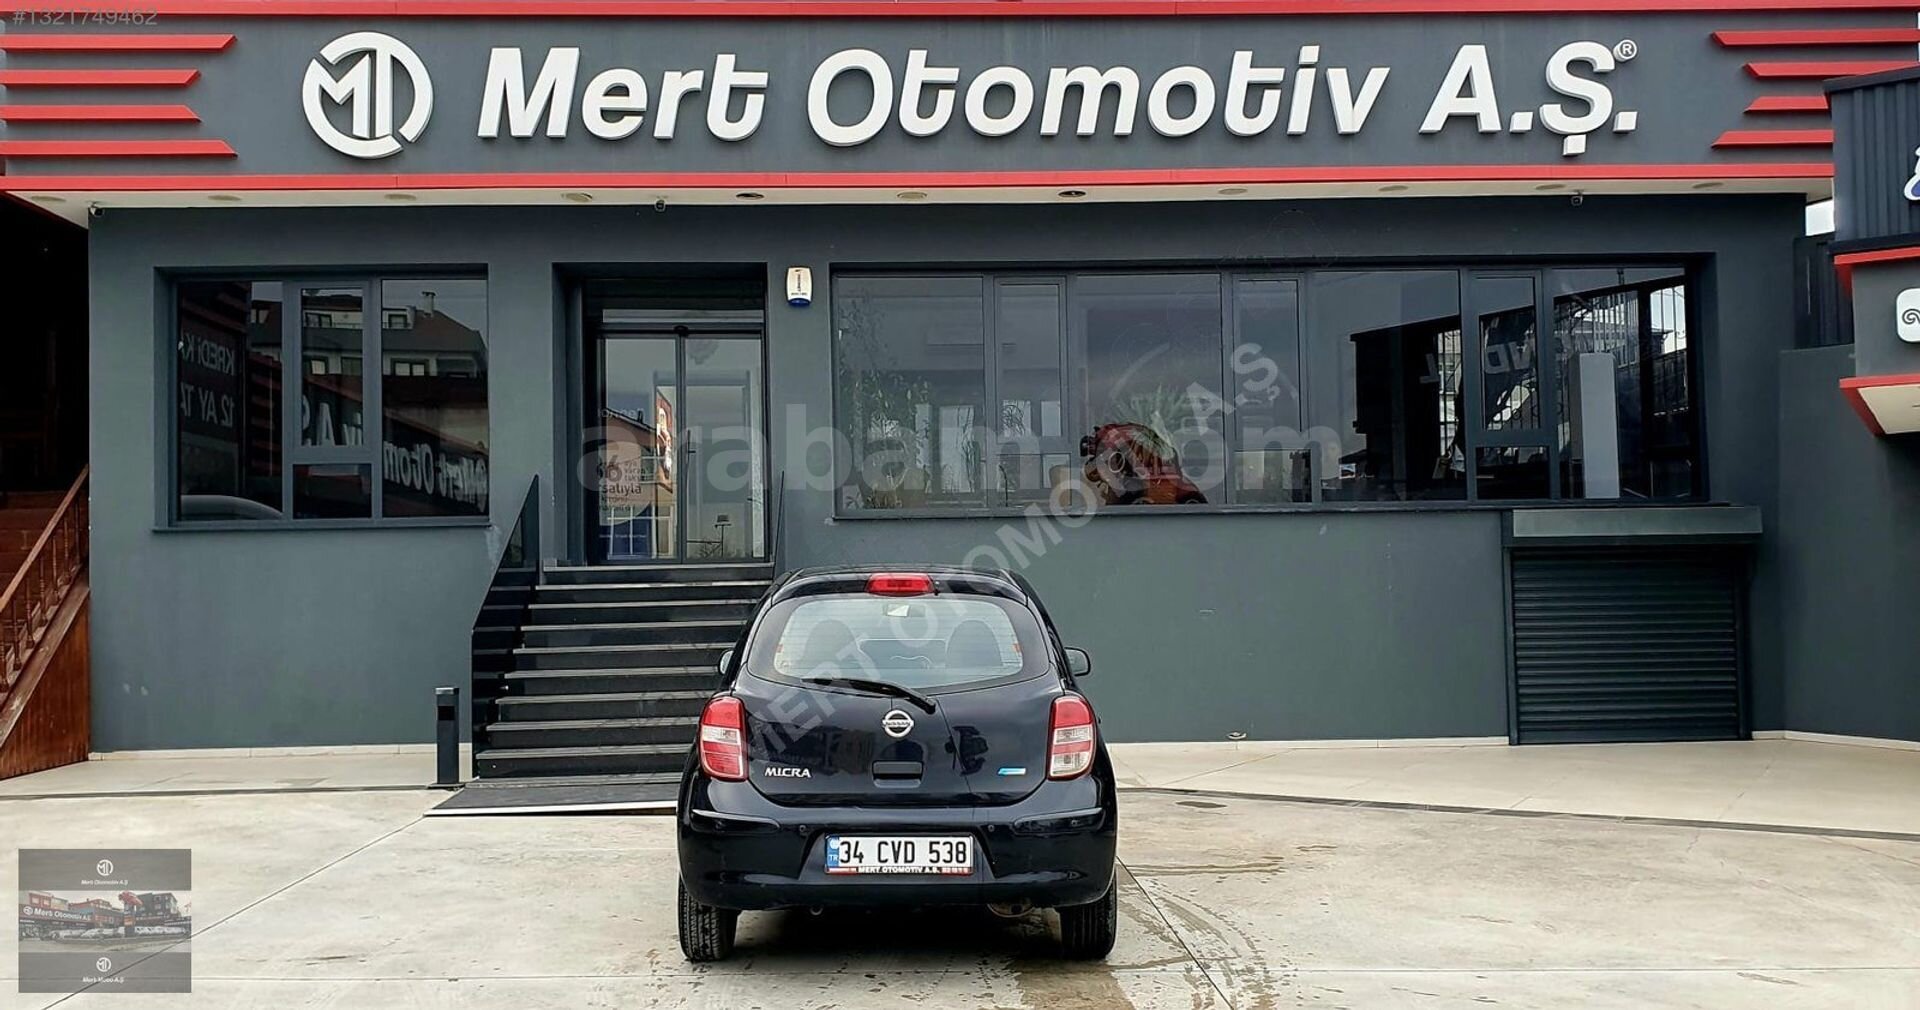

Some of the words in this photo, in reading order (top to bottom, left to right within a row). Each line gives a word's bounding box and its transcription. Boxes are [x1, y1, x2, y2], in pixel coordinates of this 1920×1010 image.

[477, 46, 769, 141] Mert
[806, 44, 1390, 147] Otomotiv
[1418, 40, 1638, 157] A.Ş.
[764, 767, 812, 778] MICRA
[839, 841, 864, 864] 34
[877, 841, 915, 863] CVD
[929, 841, 967, 863] 538
